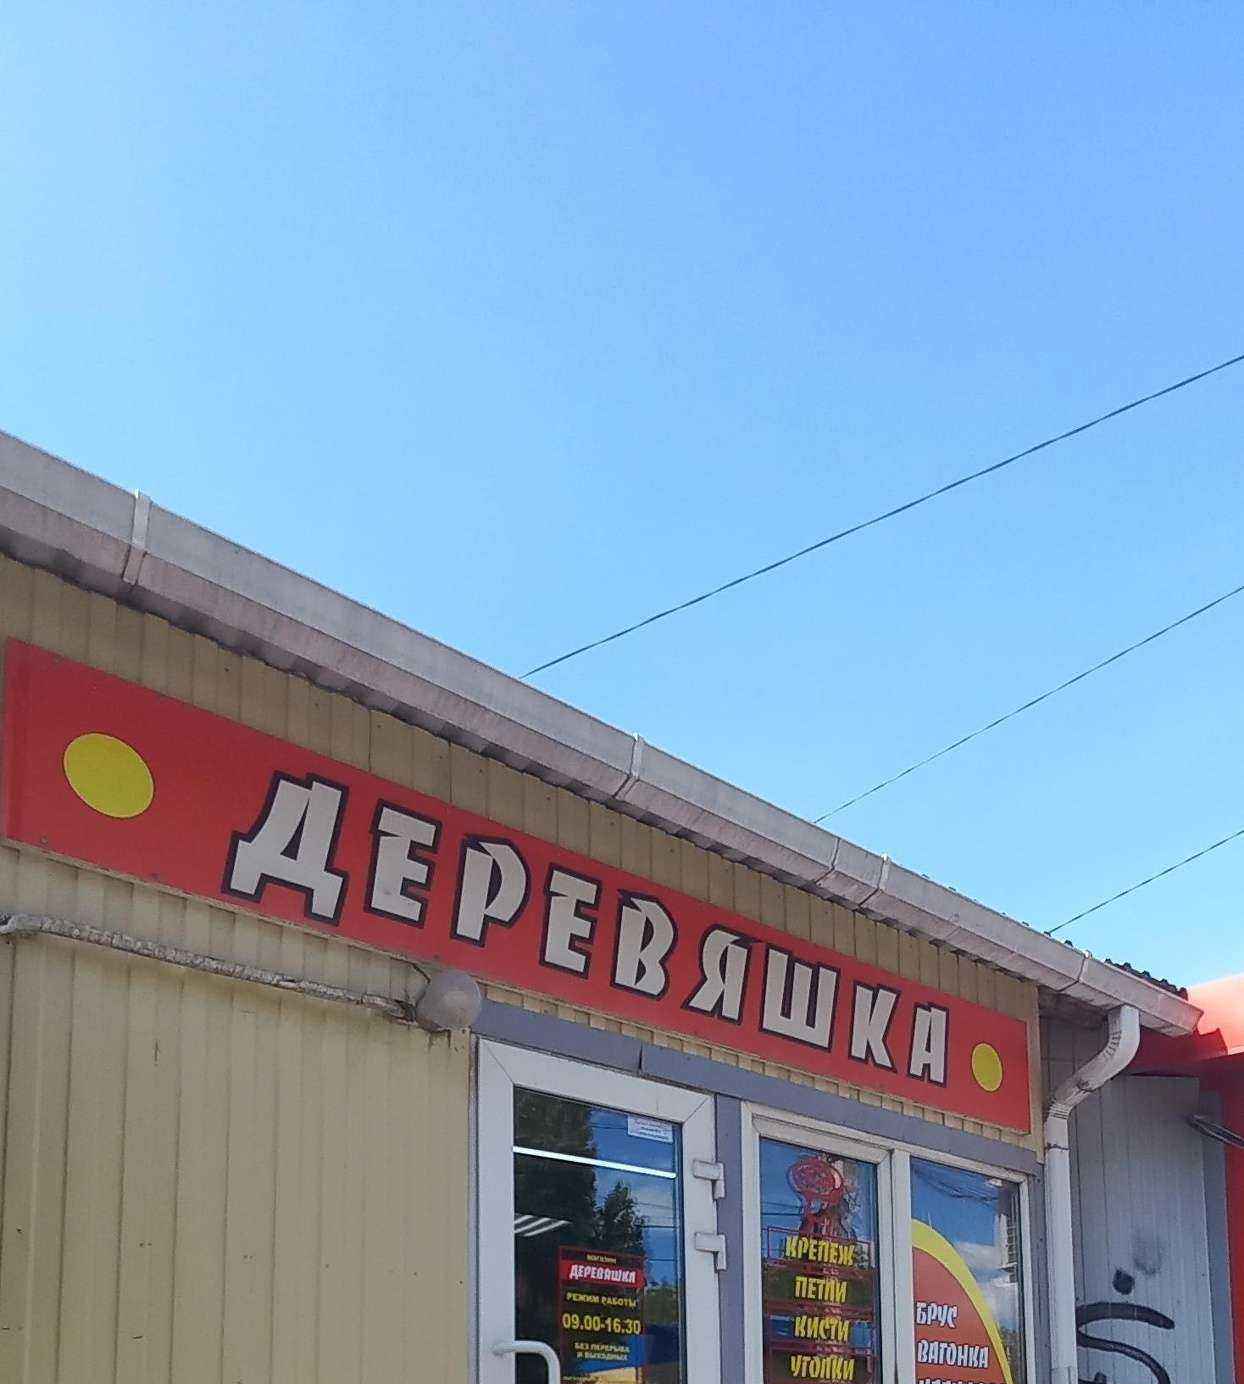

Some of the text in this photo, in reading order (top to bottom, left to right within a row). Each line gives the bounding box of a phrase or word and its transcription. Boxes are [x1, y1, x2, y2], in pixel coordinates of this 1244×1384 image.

[222, 771, 948, 1087] ДЕРЕВЯШКА
[785, 1235, 855, 1266] КРЕПЕЖ
[570, 1264, 636, 1283] ДЕРЕВЯШКА
[566, 1292, 637, 1308] РЕЖИМ РАБОТЫ
[795, 1275, 848, 1303] ПЕТЛИ
[562, 1312, 641, 1335] 09.00-16.30
[794, 1315, 849, 1342] КИСТИ
[916, 1301, 958, 1329] БРУС
[917, 1339, 989, 1369] ВАГОНКА
[790, 1355, 855, 1381] УГОЛКИ
